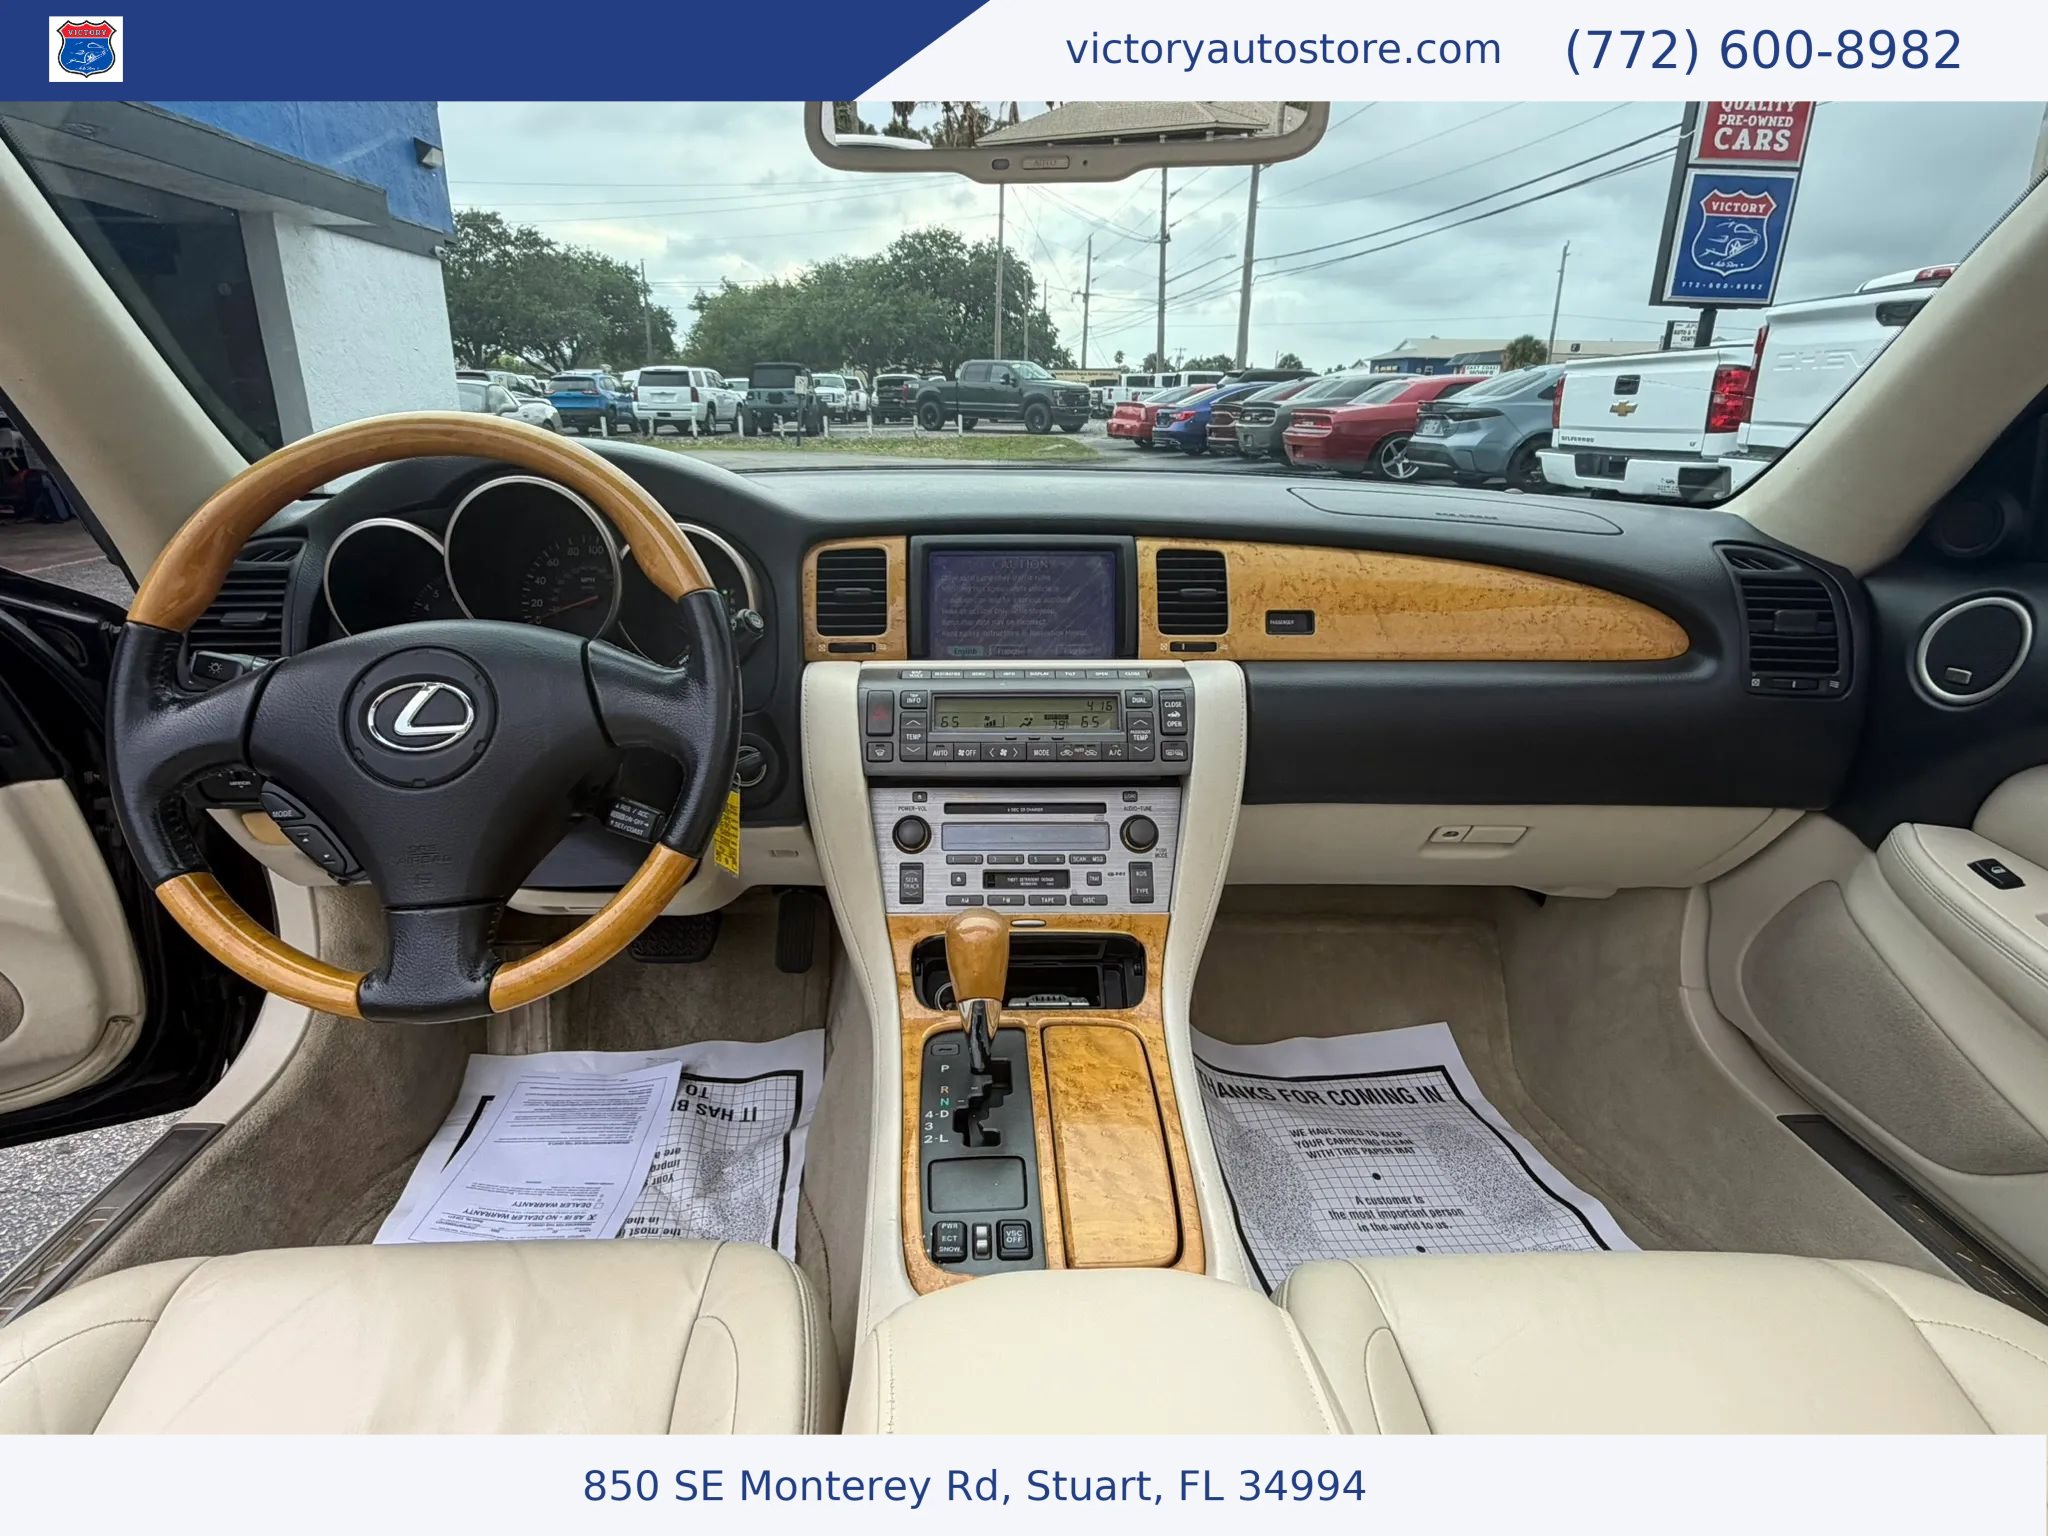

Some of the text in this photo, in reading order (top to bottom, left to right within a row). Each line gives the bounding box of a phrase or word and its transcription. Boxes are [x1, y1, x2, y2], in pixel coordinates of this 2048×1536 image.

[1717, 114, 1793, 128] PRE-OWNED
[1714, 127, 1791, 151] CARS
[1711, 201, 1767, 213] VICTORY
[905, 733, 922, 741] TEMP
[932, 749, 948, 757] AUTO
[1033, 749, 1050, 757] MODE
[272, 809, 293, 817] MODE
[941, 1064, 949, 1072] P
[685, 1084, 709, 1099] TO
[941, 1085, 949, 1094] R
[1279, 1088, 1325, 1105] FOR
[1327, 1086, 1415, 1106] COMING
[1417, 1085, 1444, 1103] IN
[941, 1098, 950, 1106] N
[696, 1103, 757, 1122] IT HAS
[924, 1122, 933, 1131] 3
[1289, 1129, 1306, 1138] WE
[1308, 1128, 1334, 1137] HAVE
[1335, 1129, 1364, 1137] TRIED
[1294, 1137, 1414, 1148] YOUR CARPETING CLEAN
[1306, 1146, 1416, 1160] WITH THIS PAPER MAT
[652, 1173, 674, 1186] Your
[511, 1200, 563, 1209] WARRANTY
[1355, 1195, 1364, 1205] A
[1366, 1195, 1413, 1205] customer
[462, 1207, 510, 1221] WARRANTY
[511, 1213, 543, 1221] DEALER
[1328, 1208, 1465, 1221] the most important person
[629, 1226, 659, 1236] most
[1357, 1222, 1370, 1232] in
[1370, 1222, 1389, 1232] the
[1391, 1221, 1421, 1231] world
[1422, 1221, 1434, 1230] to
